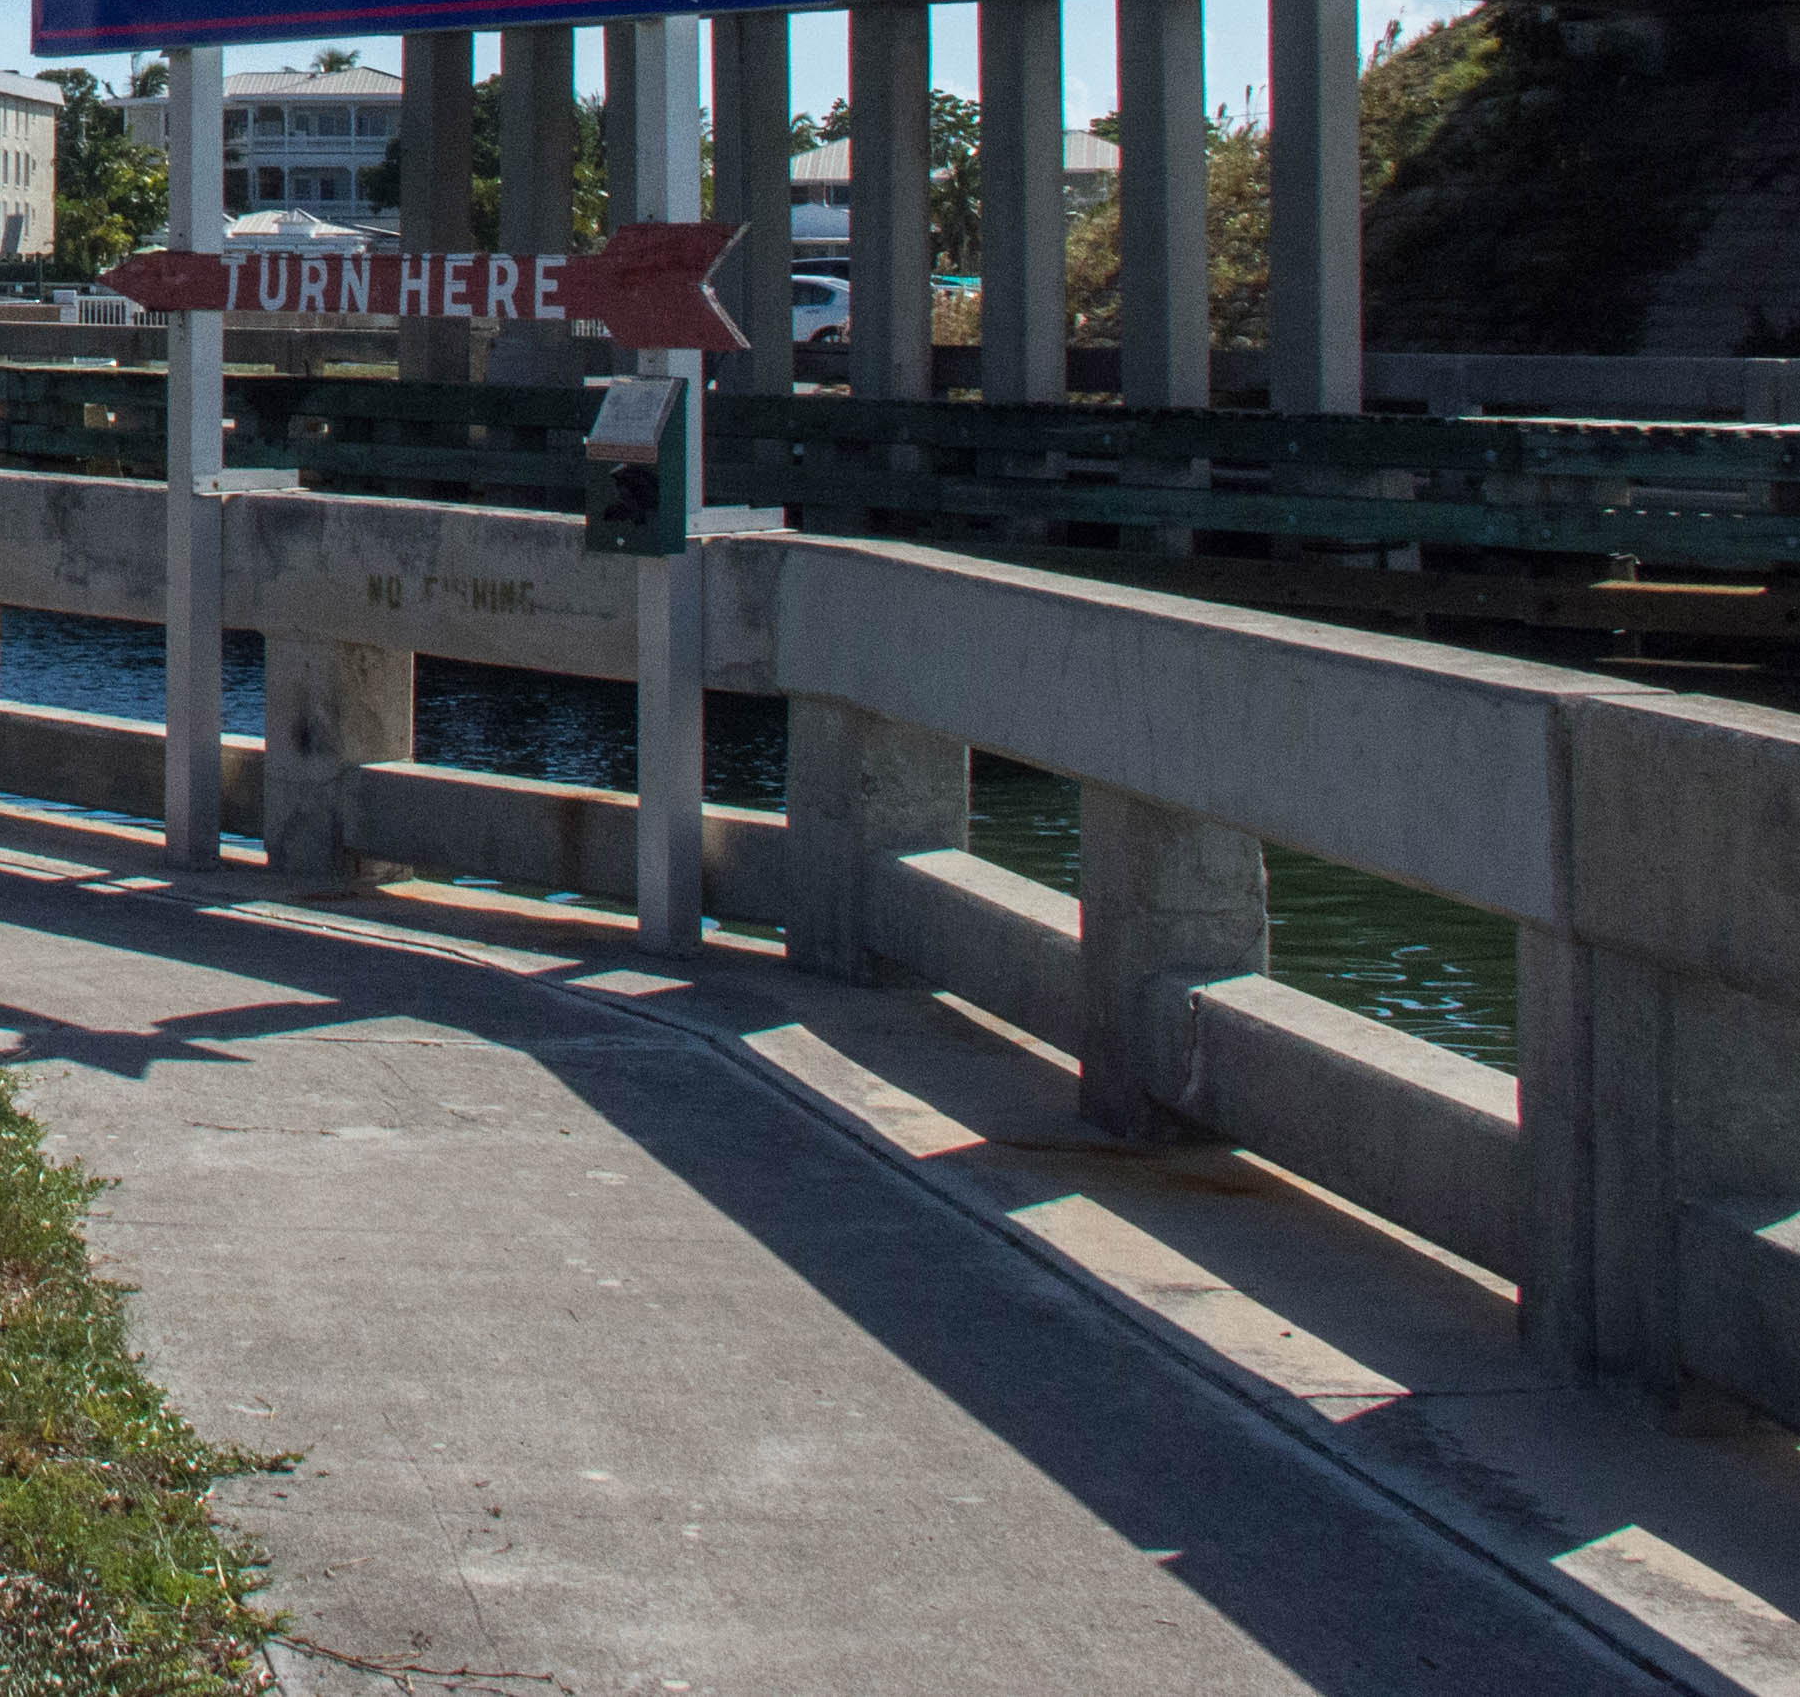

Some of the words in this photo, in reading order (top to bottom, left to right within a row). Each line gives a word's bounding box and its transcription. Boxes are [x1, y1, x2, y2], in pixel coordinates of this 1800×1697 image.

[221, 252, 370, 315] TURN
[400, 254, 566, 319] HERE
[366, 574, 402, 610] NO
